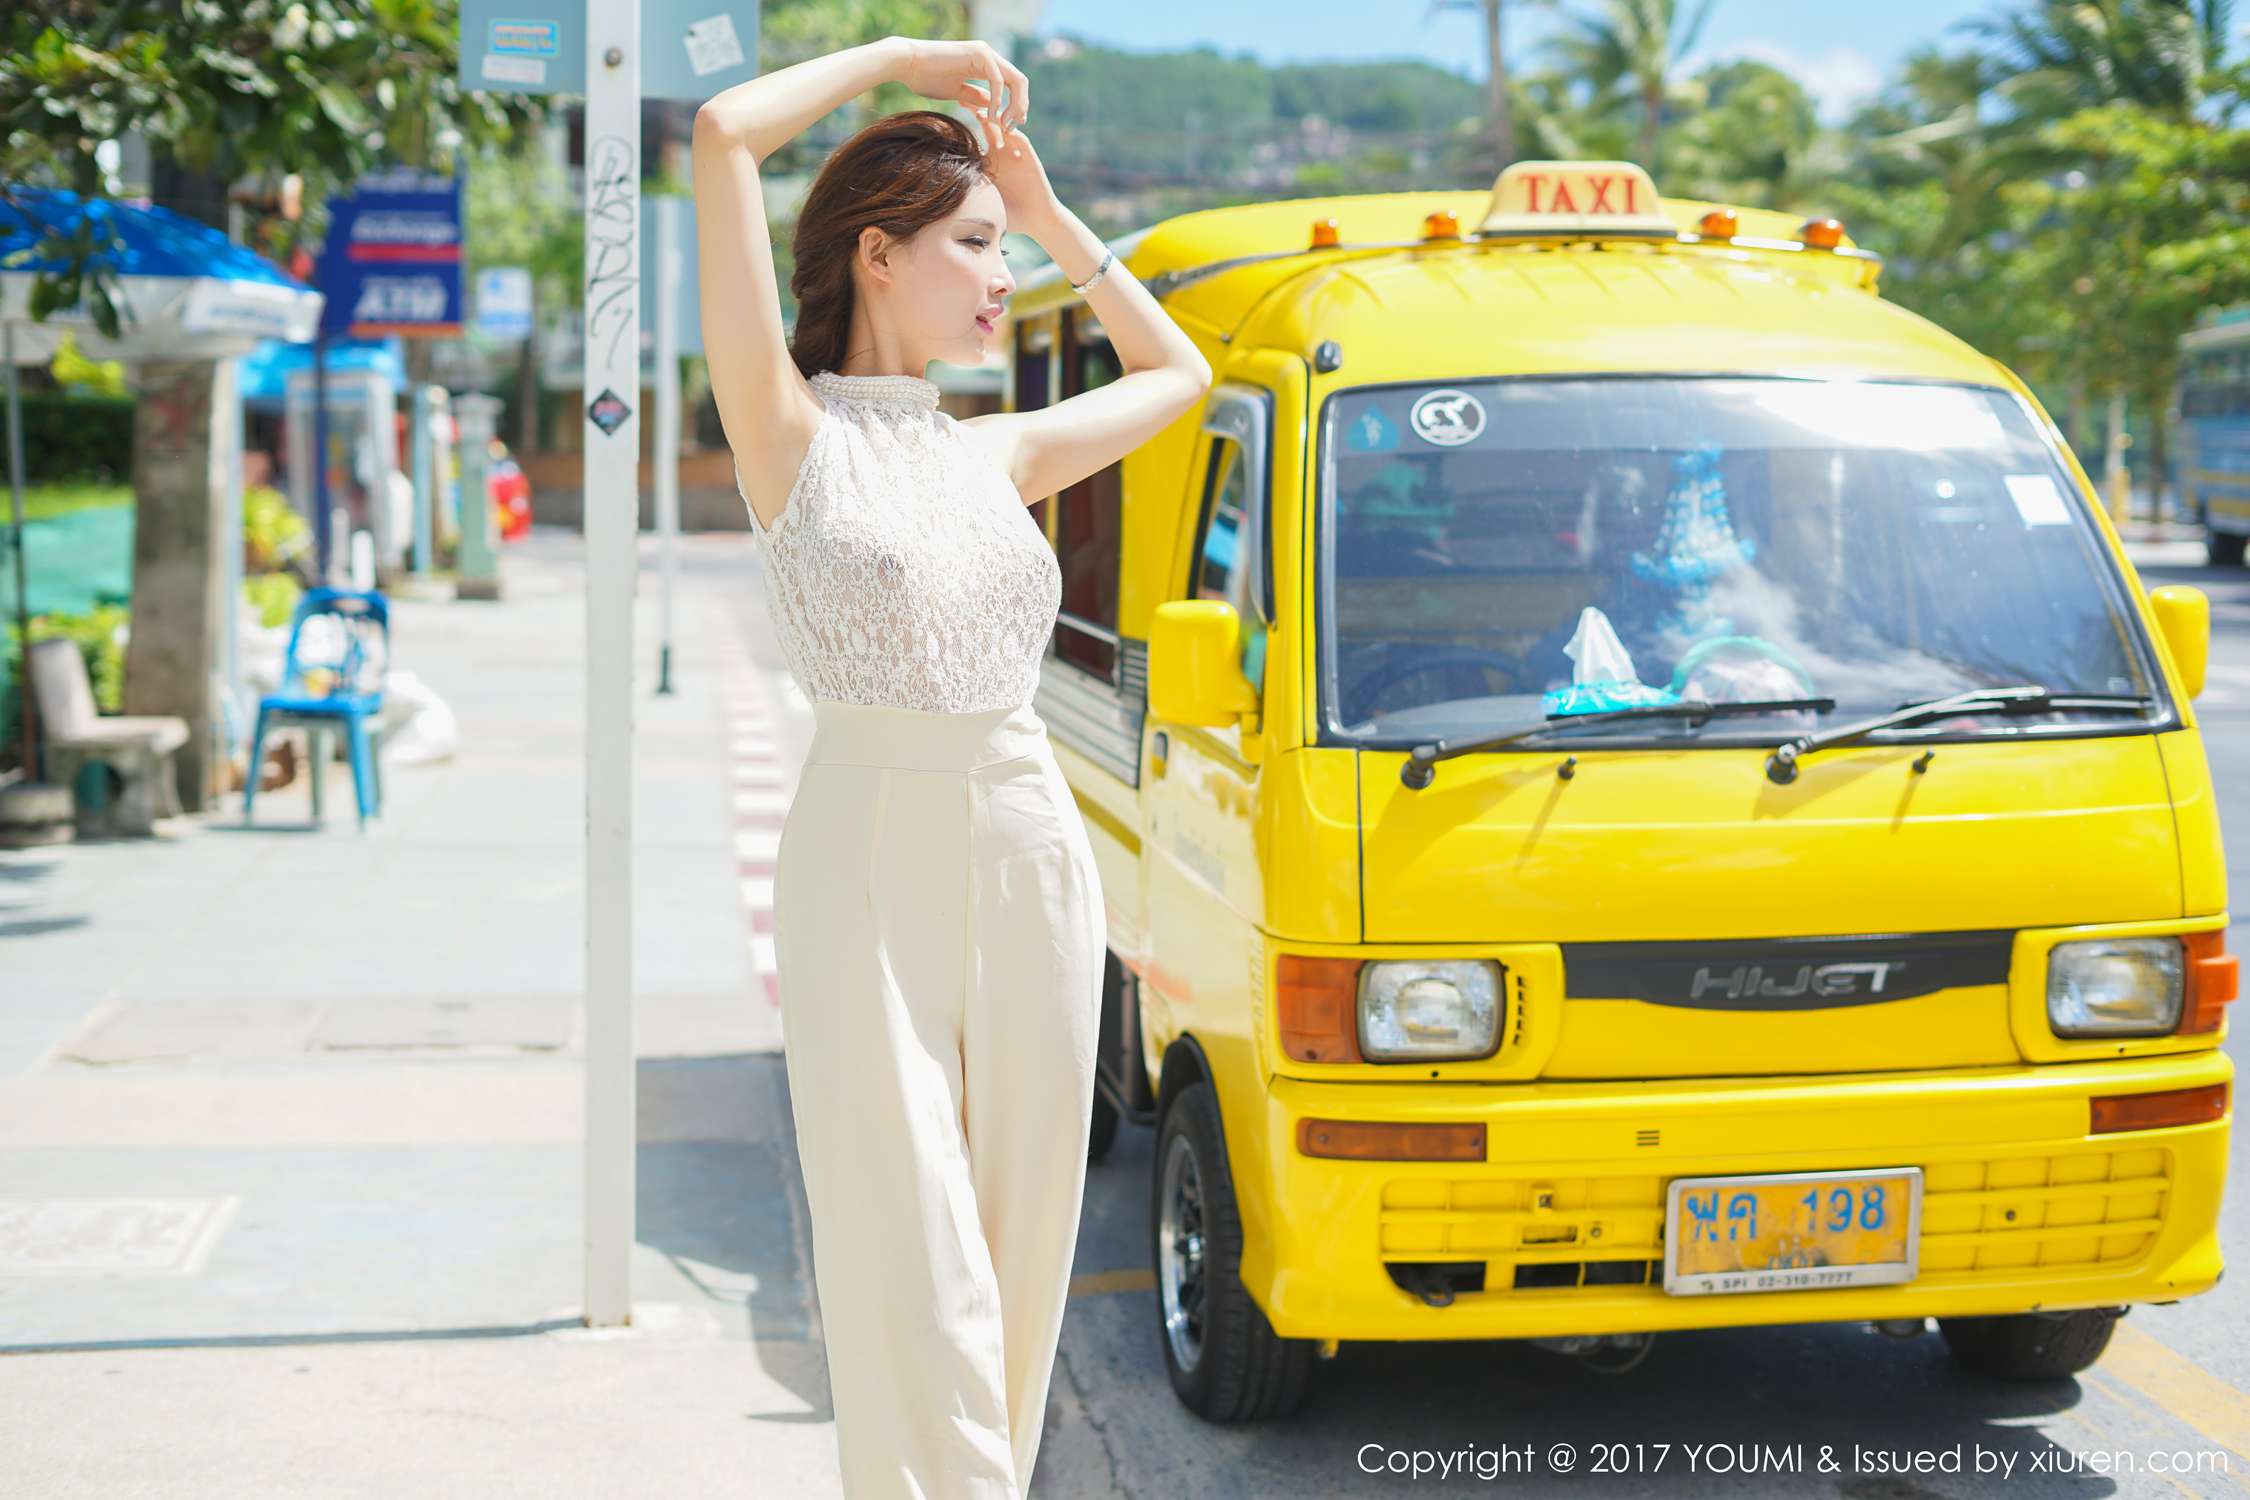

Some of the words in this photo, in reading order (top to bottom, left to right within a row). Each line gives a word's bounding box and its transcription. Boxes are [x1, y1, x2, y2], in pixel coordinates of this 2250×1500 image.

[1518, 173, 1638, 215] TAXI
[352, 284, 447, 320] ATM
[1690, 961, 1906, 999] HIJET
[1803, 1184, 1886, 1233] 198
